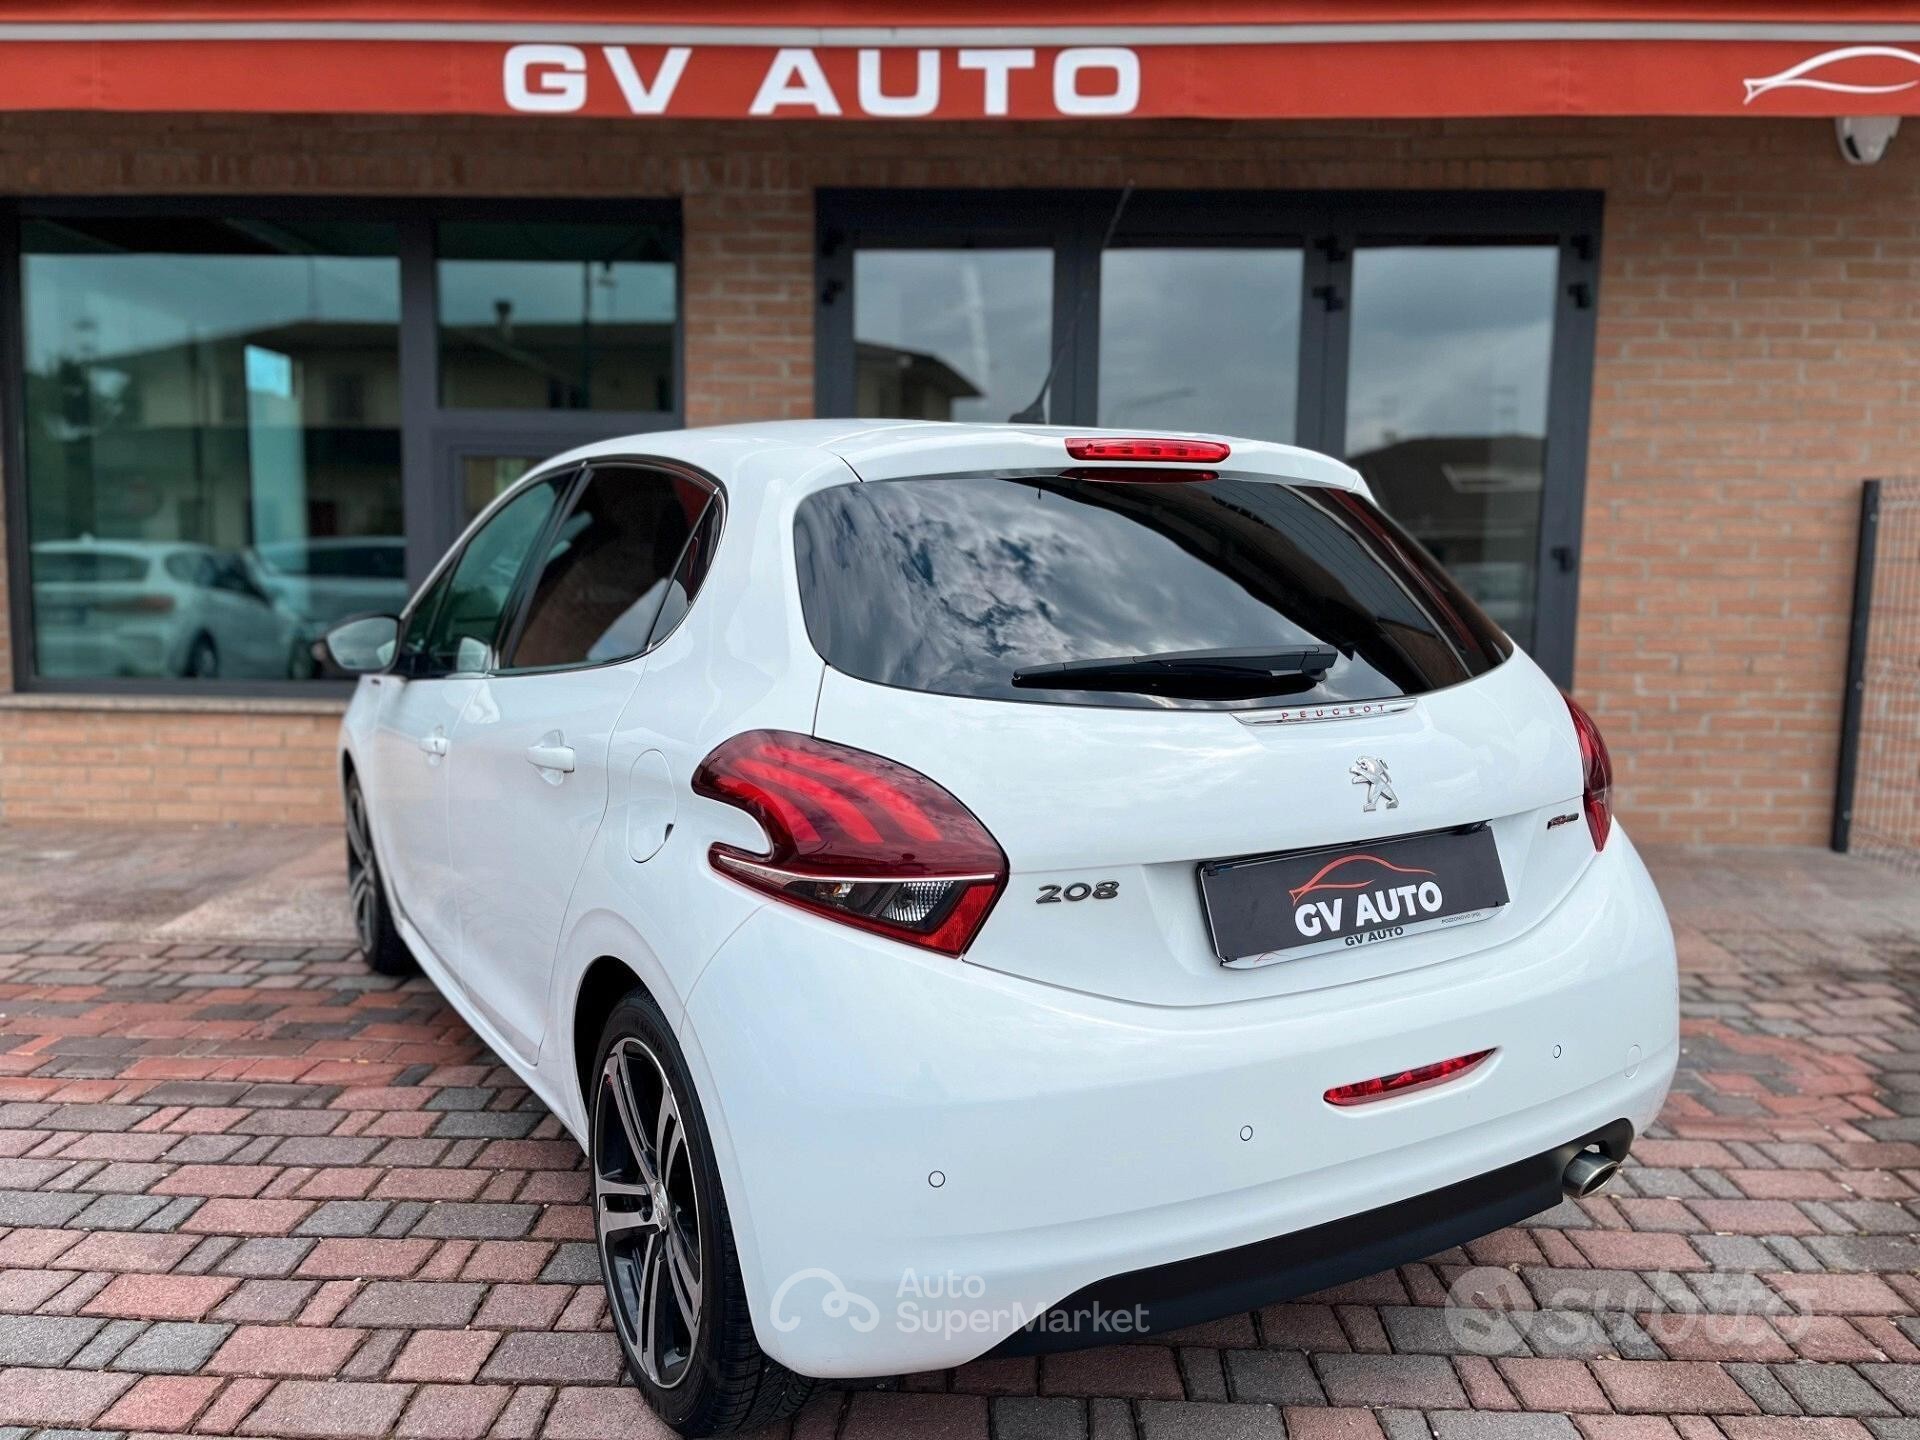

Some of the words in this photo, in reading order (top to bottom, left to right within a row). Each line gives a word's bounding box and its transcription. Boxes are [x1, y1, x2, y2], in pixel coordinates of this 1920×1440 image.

[503, 45, 692, 116] GV
[748, 47, 1141, 118] AUTO
[1281, 704, 1385, 721] PEUGEOT
[1035, 880, 1120, 904] 208
[1294, 898, 1343, 937] GV
[1355, 881, 1443, 927] AUTO
[1345, 934, 1364, 946] GV
[1368, 926, 1404, 942] AUTO
